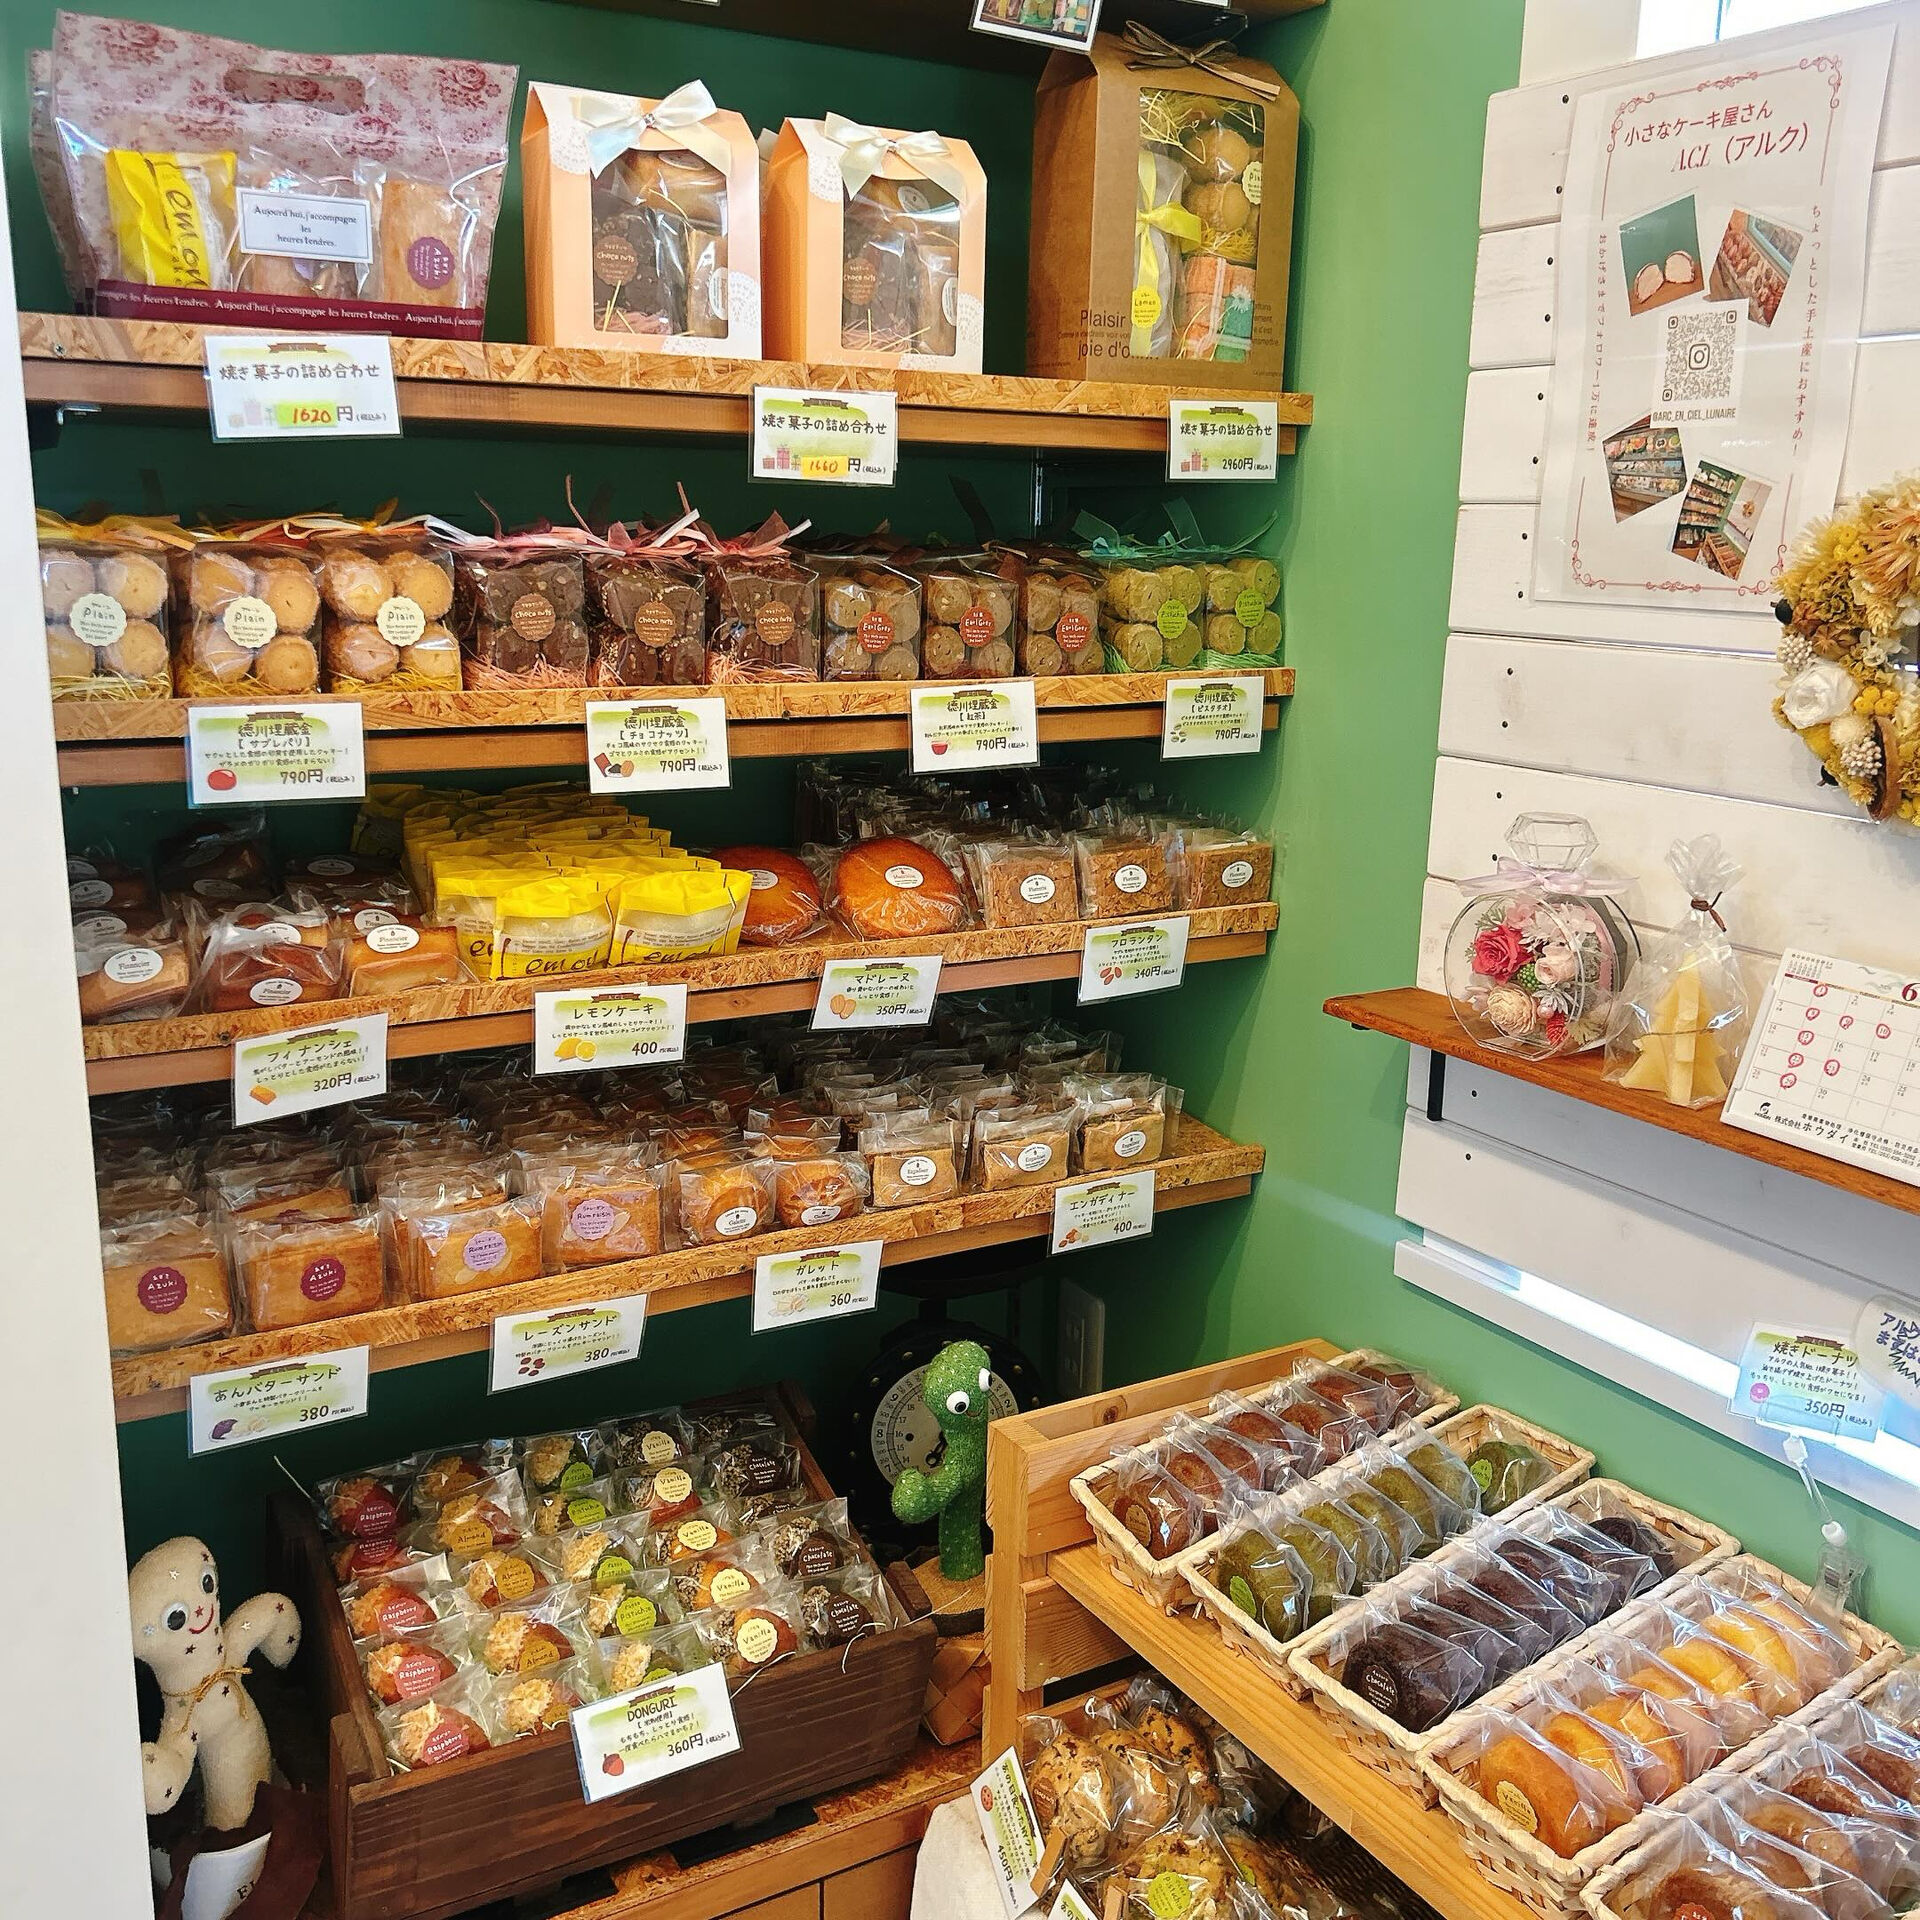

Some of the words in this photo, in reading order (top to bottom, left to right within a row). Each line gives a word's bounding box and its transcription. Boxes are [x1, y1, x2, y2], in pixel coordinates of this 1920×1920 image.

[1624, 100, 1772, 147] 小さなケーキ屋さん
[300, 224, 312, 233] les
[277, 234, 304, 245] heures
[143, 294, 172, 306] heures
[328, 308, 340, 318] les
[341, 309, 368, 320] heures
[1080, 309, 1126, 328] Plaisir
[1078, 340, 1103, 361] joie
[219, 363, 381, 381] 焼き菓子の詰め合わせ
[762, 414, 887, 435] 焼き菓子の詰め合わせ
[1180, 422, 1272, 436] 焼き菓子の詰め合わせ
[83, 607, 115, 620] Plain
[235, 611, 265, 623] Plain
[387, 611, 415, 622] Plain
[515, 610, 537, 619] Choco
[537, 609, 551, 617] nuts
[638, 615, 659, 625] Choco
[759, 616, 780, 624] Choco
[624, 715, 686, 730] 徳川埋蔵金
[238, 723, 313, 738] 徳川埋蔵金
[1215, 727, 1241, 740] 790円
[976, 737, 1006, 751] 790円
[660, 758, 696, 773] 790円
[280, 768, 323, 785] 790円
[1111, 934, 1163, 948] フロランタン
[854, 972, 910, 984] マドレーヌ
[1134, 965, 1161, 979] 340円
[1901, 982, 1920, 1002] 6
[574, 1002, 654, 1020] レモンケーキ
[876, 1003, 906, 1016] 350円
[1879, 1027, 1888, 1035] 10
[268, 1039, 352, 1063] フィナンシェ
[632, 1041, 658, 1056] 400
[1835, 1041, 1843, 1049] 16
[1870, 1051, 1879, 1059] 17
[1907, 1060, 1916, 1069] 18
[313, 1072, 352, 1092] 320円
[1861, 1074, 1871, 1083] 24
[1818, 1087, 1828, 1096] 30
[1070, 1191, 1135, 1211] エンガディナー
[1113, 1220, 1132, 1234] 400
[796, 1260, 839, 1276] ガレット
[308, 1269, 337, 1282] Azuki
[147, 1280, 178, 1291] Azuki
[829, 1292, 851, 1307] 360
[524, 1315, 618, 1341] レーズンサンド
[584, 1347, 610, 1363] 380
[1773, 1341, 1858, 1367] 焼きドーナツ
[214, 1366, 342, 1403] あんバターサンド
[300, 1405, 329, 1422] 380
[1804, 1399, 1845, 1419] 350円
[876, 1429, 883, 1437] 8
[645, 1439, 670, 1450] Vanilla
[660, 1475, 687, 1485] Vanilla
[458, 1532, 486, 1543] Almond
[682, 1525, 709, 1538] Vanilla
[803, 1551, 833, 1562] Chocolate
[502, 1569, 528, 1581] Almond
[716, 1580, 745, 1592] Vanilla
[382, 1606, 418, 1622] Raspberry
[830, 1604, 859, 1618] Chocolate
[743, 1628, 772, 1645] Vanilla
[527, 1652, 554, 1665] Almond
[399, 1665, 436, 1679] Raspberry
[1366, 1674, 1396, 1697] Chocolate
[627, 1695, 678, 1722] DONGURI
[427, 1732, 462, 1754] Raspberry
[667, 1732, 704, 1757] 360円
[998, 1844, 1014, 1881] 450円
